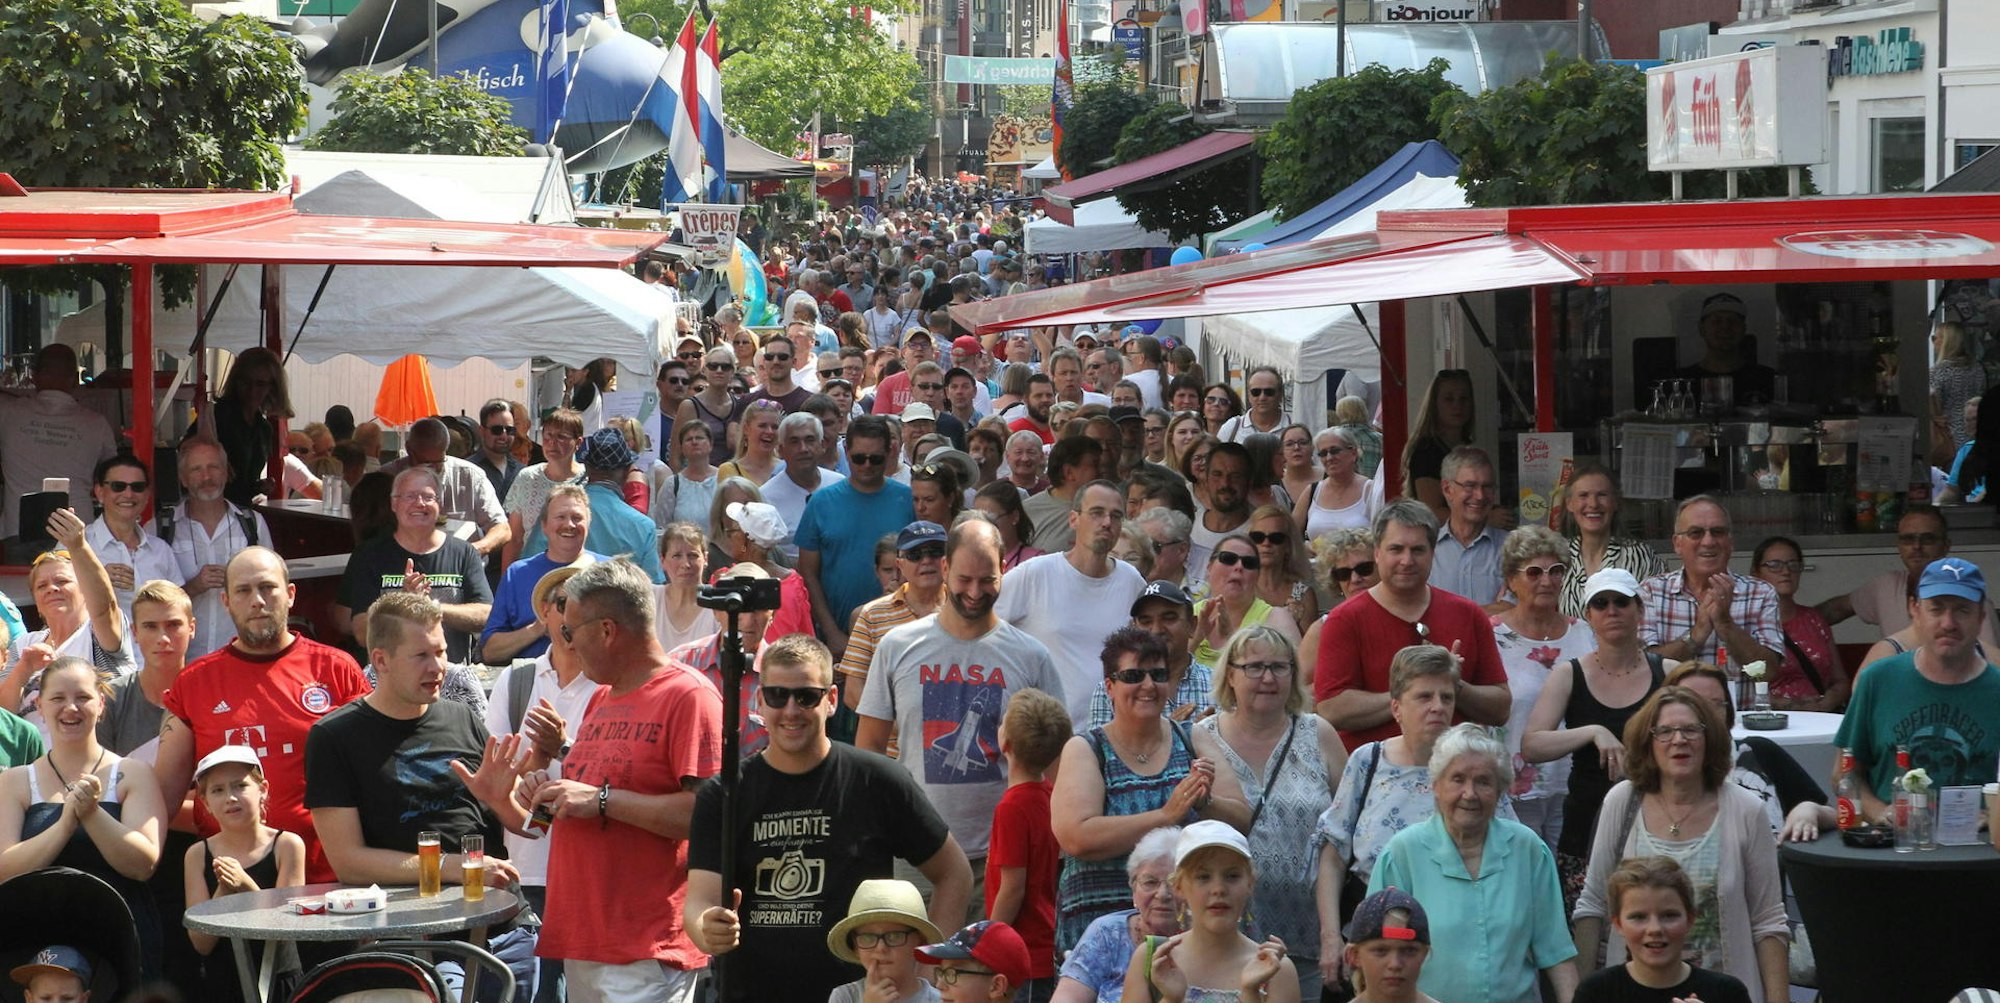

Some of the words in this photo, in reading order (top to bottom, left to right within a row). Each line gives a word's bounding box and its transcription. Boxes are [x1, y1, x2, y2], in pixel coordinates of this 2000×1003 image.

[682, 209, 738, 234] Crêpes
[920, 664, 1006, 689] NASA
[753, 816, 831, 842] MOMENTE
[749, 908, 823, 924] SUPERKRÄFTE?
